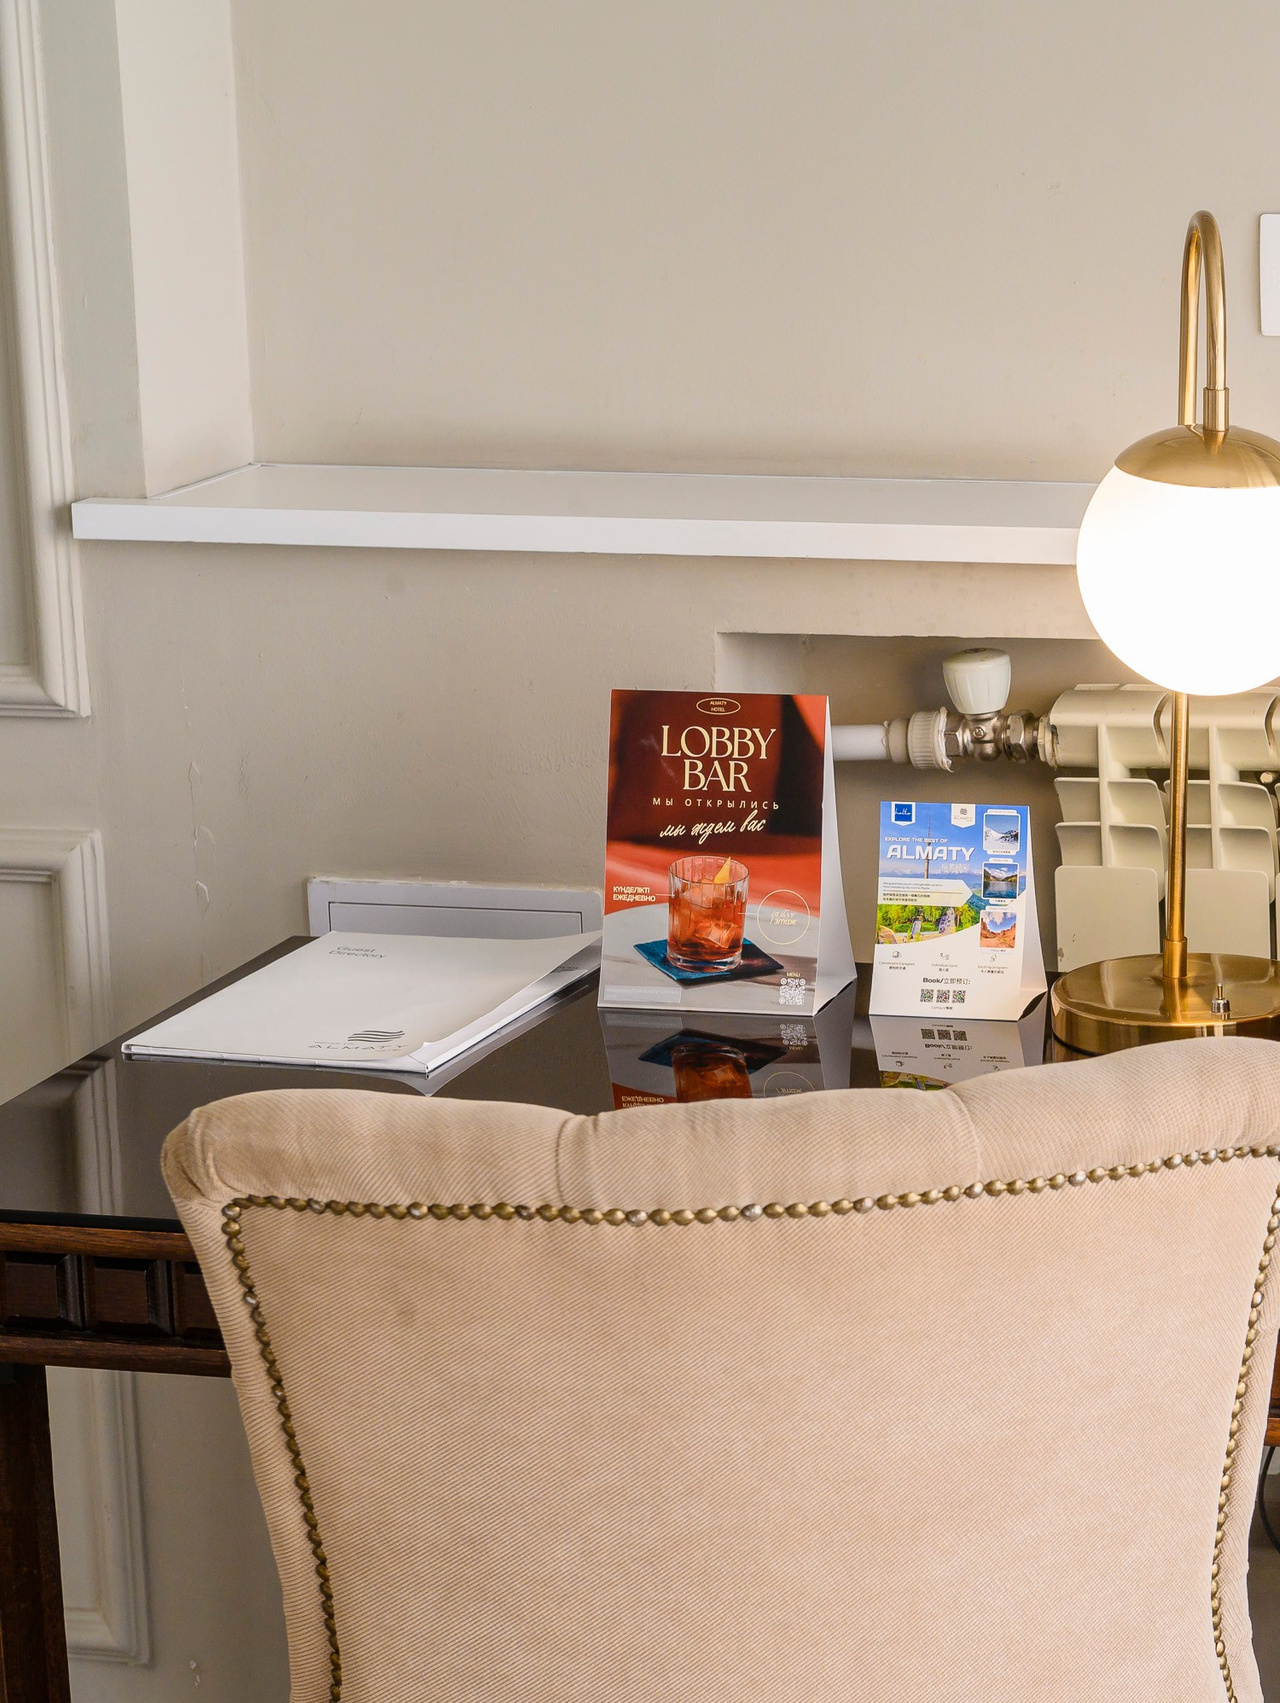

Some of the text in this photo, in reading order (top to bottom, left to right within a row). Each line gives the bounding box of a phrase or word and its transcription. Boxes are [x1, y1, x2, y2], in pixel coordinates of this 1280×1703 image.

[661, 725, 777, 759] LOBBY
[683, 759, 752, 793] BAR
[652, 797, 779, 810] МЫ ОТКРЫЛИСЬ
[660, 809, 766, 845] мы ждем вас
[887, 844, 976, 862] ALMATY
[613, 893, 656, 903] ЕЖЕДНЕВНО
[329, 950, 387, 958] Directory
